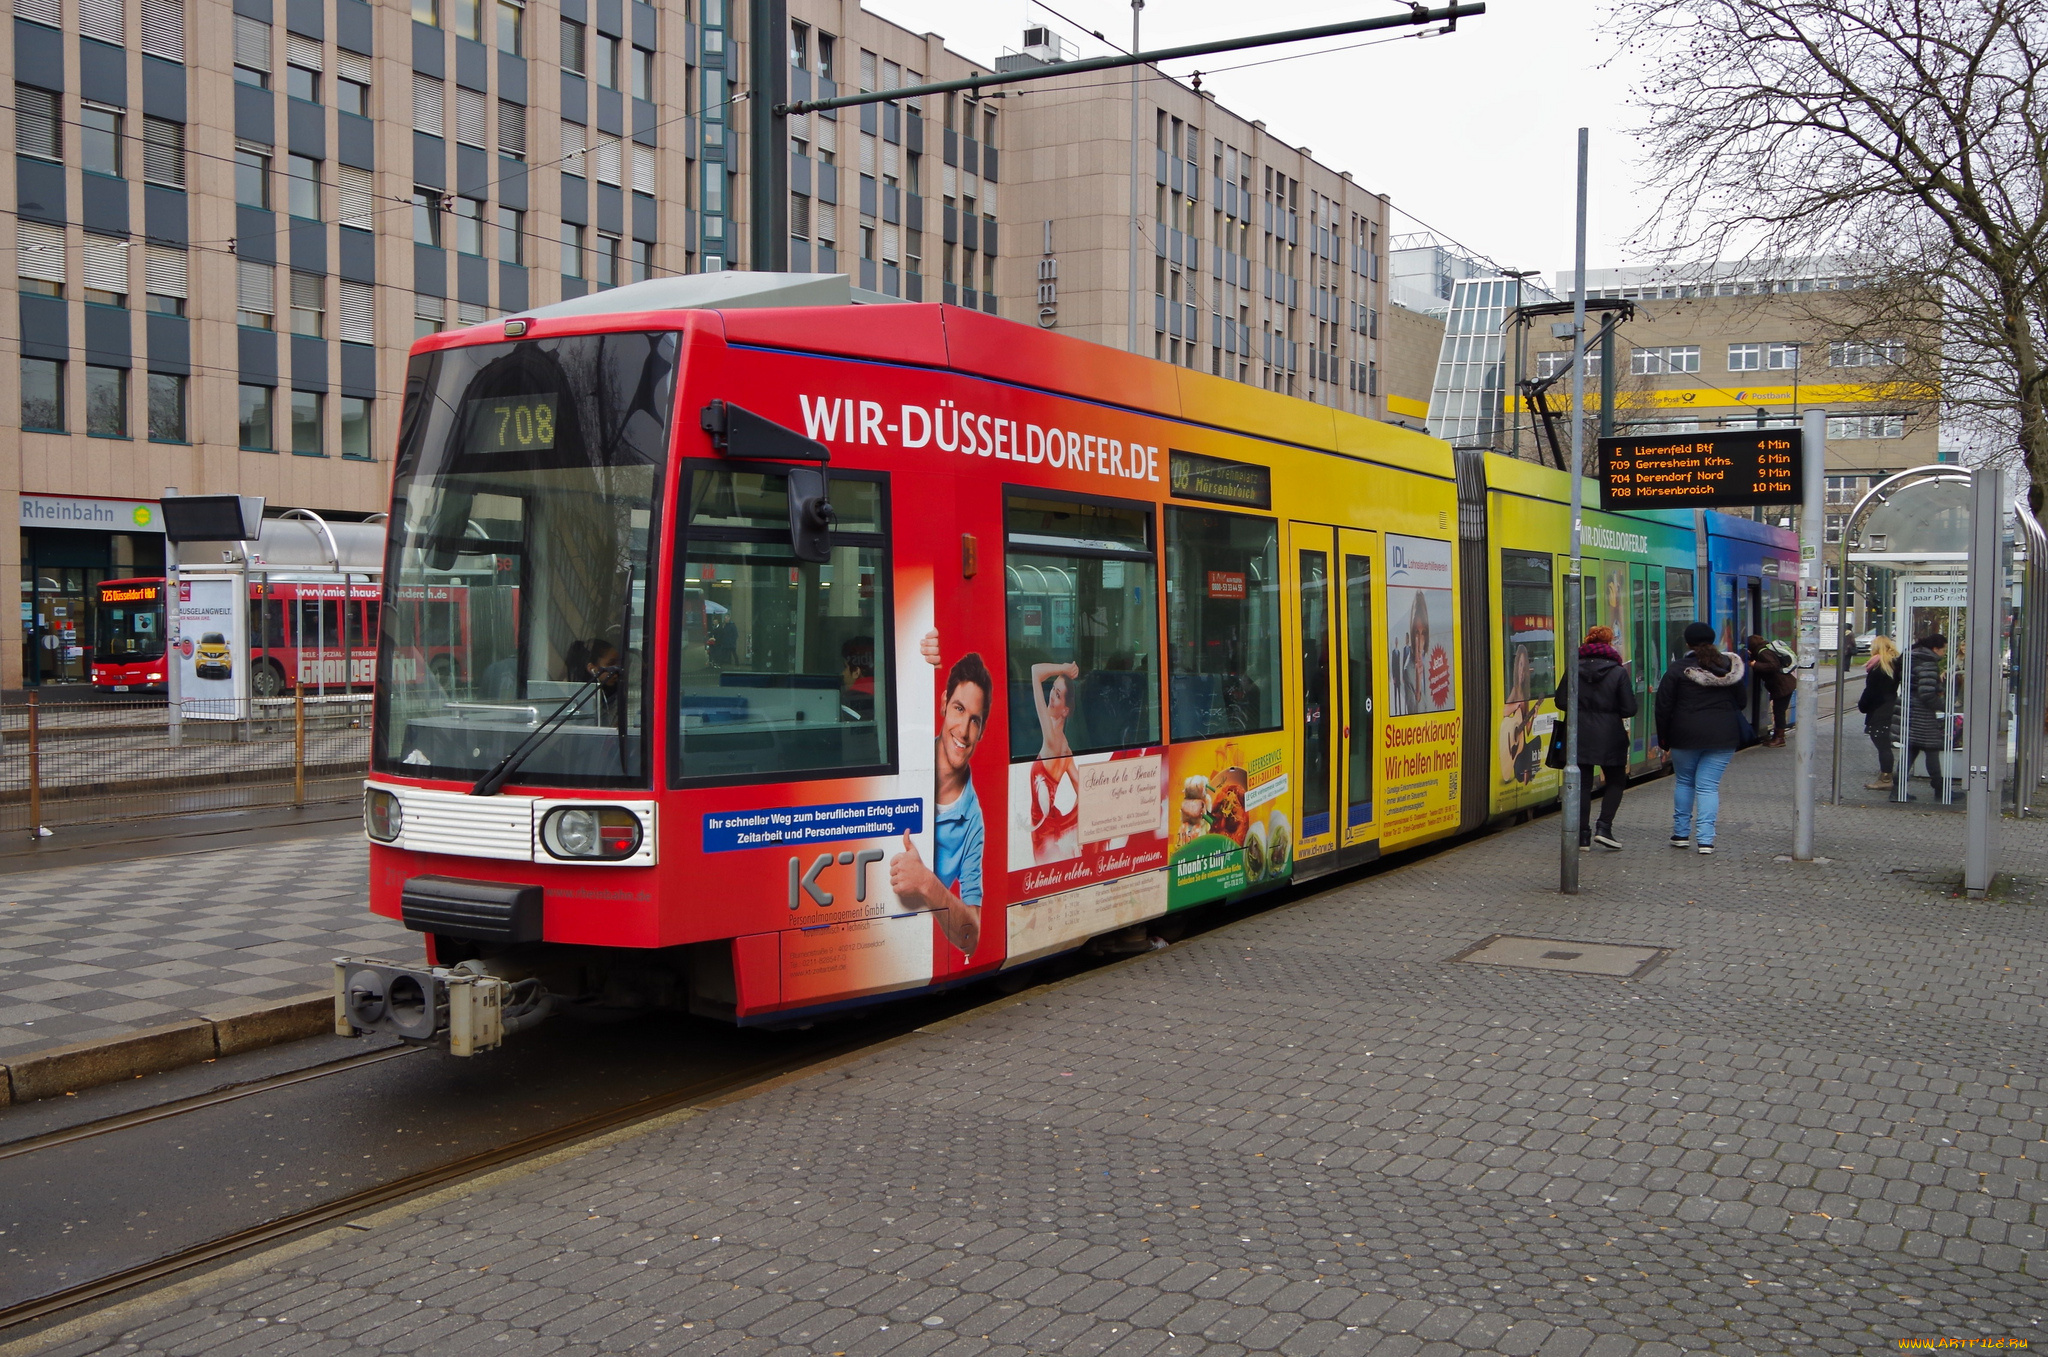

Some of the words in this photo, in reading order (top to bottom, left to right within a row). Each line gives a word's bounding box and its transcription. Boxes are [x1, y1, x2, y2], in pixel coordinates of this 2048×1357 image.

[1752, 392, 1791, 400] Postbank
[494, 404, 554, 446] 708
[800, 394, 1159, 482] WIR-DÜSSELDORFER.DE
[1615, 447, 1622, 457] E
[1635, 444, 1692, 456] Lierenfeld
[1697, 443, 1714, 454] Btf
[1757, 440, 1765, 449] 4
[1768, 440, 1790, 449] Min
[1610, 461, 1630, 470] 709
[1636, 458, 1700, 469] Gerresheim
[1705, 457, 1734, 466] Krhs.
[1758, 454, 1765, 463] 6
[1769, 454, 1790, 463] Min
[1610, 474, 1630, 484] 704
[1636, 471, 1693, 483] Derendorf
[1697, 470, 1724, 480] Nord
[1758, 468, 1765, 478] 9
[1769, 468, 1790, 478] Min
[1196, 477, 1256, 499] Mörsenbroich
[1611, 487, 1631, 497] 708
[1637, 485, 1714, 496] Mörsenbroich
[1752, 482, 1766, 492] 10
[1769, 482, 1791, 491] Min
[22, 500, 114, 522] Rheinbahn
[1580, 524, 1648, 553] WIR-DÜSSELDORFER.DE
[1392, 546, 1407, 568] IDL
[102, 591, 113, 601] 725
[113, 589, 144, 601] Düsseldorf
[144, 588, 156, 600] Hbf
[1385, 716, 1461, 749] Steuererklärung?
[1247, 748, 1282, 774] LIEFERSERVICE
[1385, 756, 1402, 780] Wir
[1403, 752, 1431, 777] helfen
[1433, 746, 1459, 772] Ihnen!
[1083, 768, 1109, 791] Atelier
[1111, 768, 1120, 783] de
[1122, 768, 1128, 782] la
[1132, 765, 1158, 781] Beauté
[709, 818, 723, 829] Ihr
[725, 815, 769, 828] schneller
[770, 814, 791, 826] Weg
[793, 812, 813, 823] zum
[815, 808, 865, 821] beruflichen
[867, 804, 893, 817] Erfolg
[895, 803, 919, 814] durch
[737, 829, 782, 844] Zeitarbeit
[784, 828, 803, 839] und
[805, 822, 895, 838] Personalvermittlung.
[1022, 868, 1062, 894] Schönheit
[1064, 862, 1093, 882] erleben,
[1096, 852, 1130, 876] Schönheit
[1132, 851, 1163, 872] geniessen.
[1177, 855, 1207, 876] Khanh's
[1210, 850, 1225, 870] Lilly
[789, 849, 884, 911] KT
[789, 908, 863, 926] Personalmanagement
[864, 903, 885, 917] GmbH
[846, 921, 871, 932] Technisch
[857, 940, 885, 949] Düsseldorf
